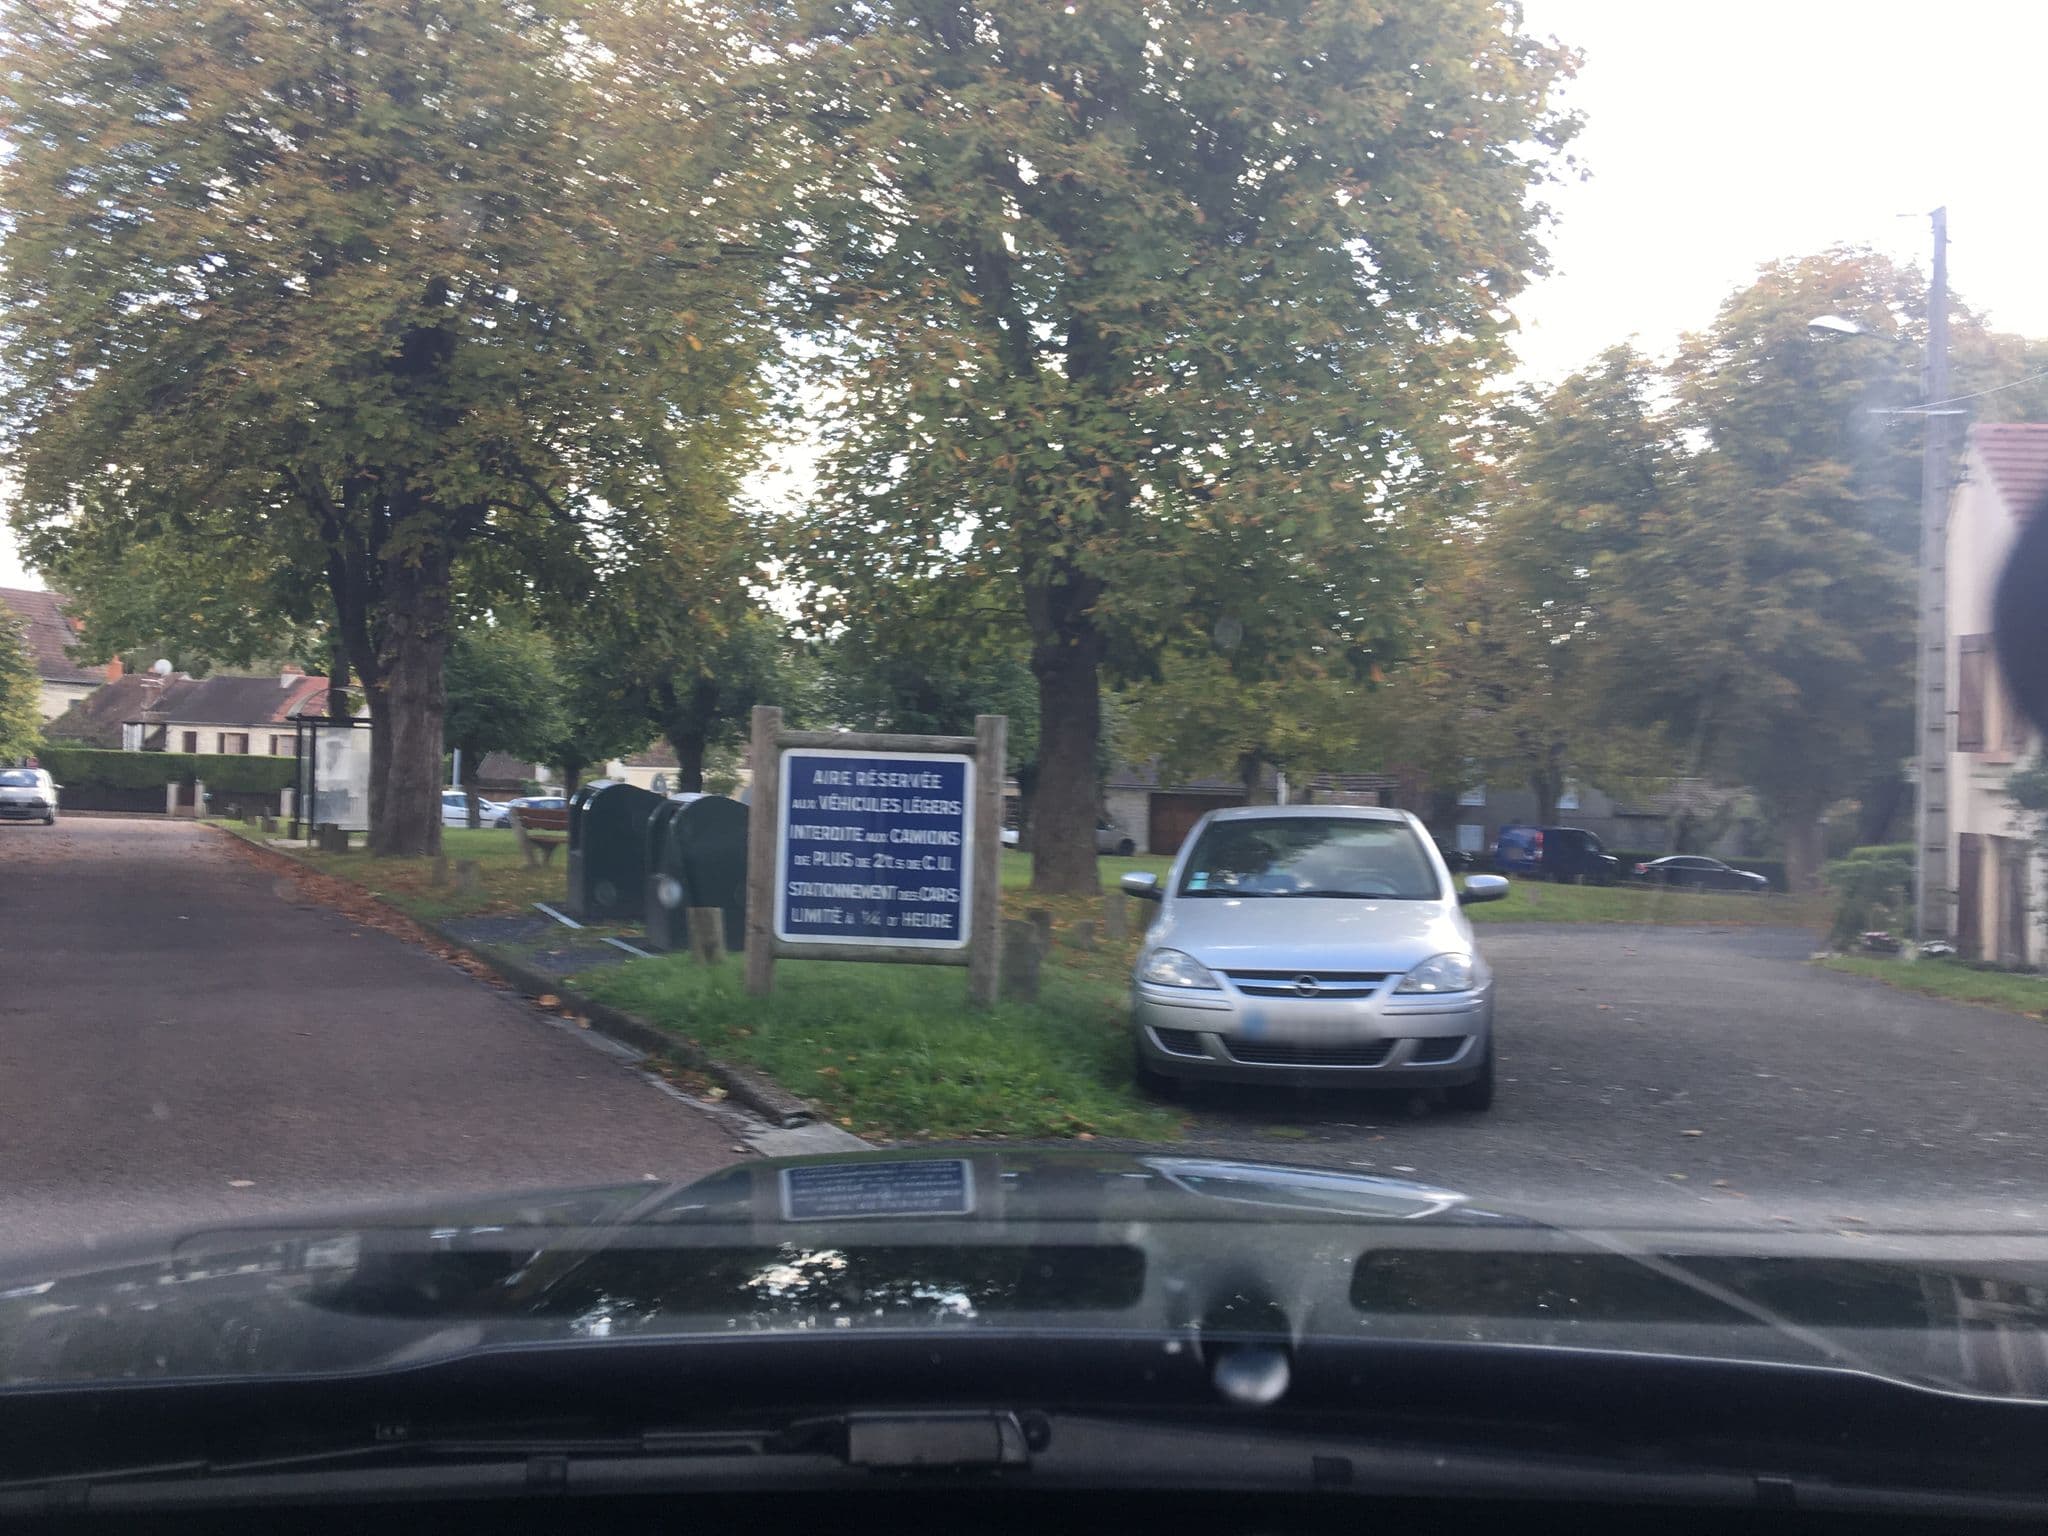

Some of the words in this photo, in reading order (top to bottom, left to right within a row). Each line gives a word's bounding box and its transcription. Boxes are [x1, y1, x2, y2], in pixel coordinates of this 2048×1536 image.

[812, 769, 852, 786] AIRE
[855, 769, 943, 789] RÉSERVÉE
[792, 799, 816, 809] AUX
[818, 794, 901, 813] VÉHICULES
[902, 796, 962, 815] LÉGERS
[790, 825, 864, 842] INTERDITE
[865, 832, 888, 843] AUX
[890, 829, 960, 846] CAMIONS
[794, 854, 811, 866] DE
[813, 851, 853, 867] PLUS
[855, 857, 871, 868] DE
[906, 859, 922, 870] DE
[788, 881, 898, 900] STATIONNEMENT
[898, 890, 920, 901] DES
[920, 886, 961, 902] CARS
[901, 911, 953, 928] HEURE
